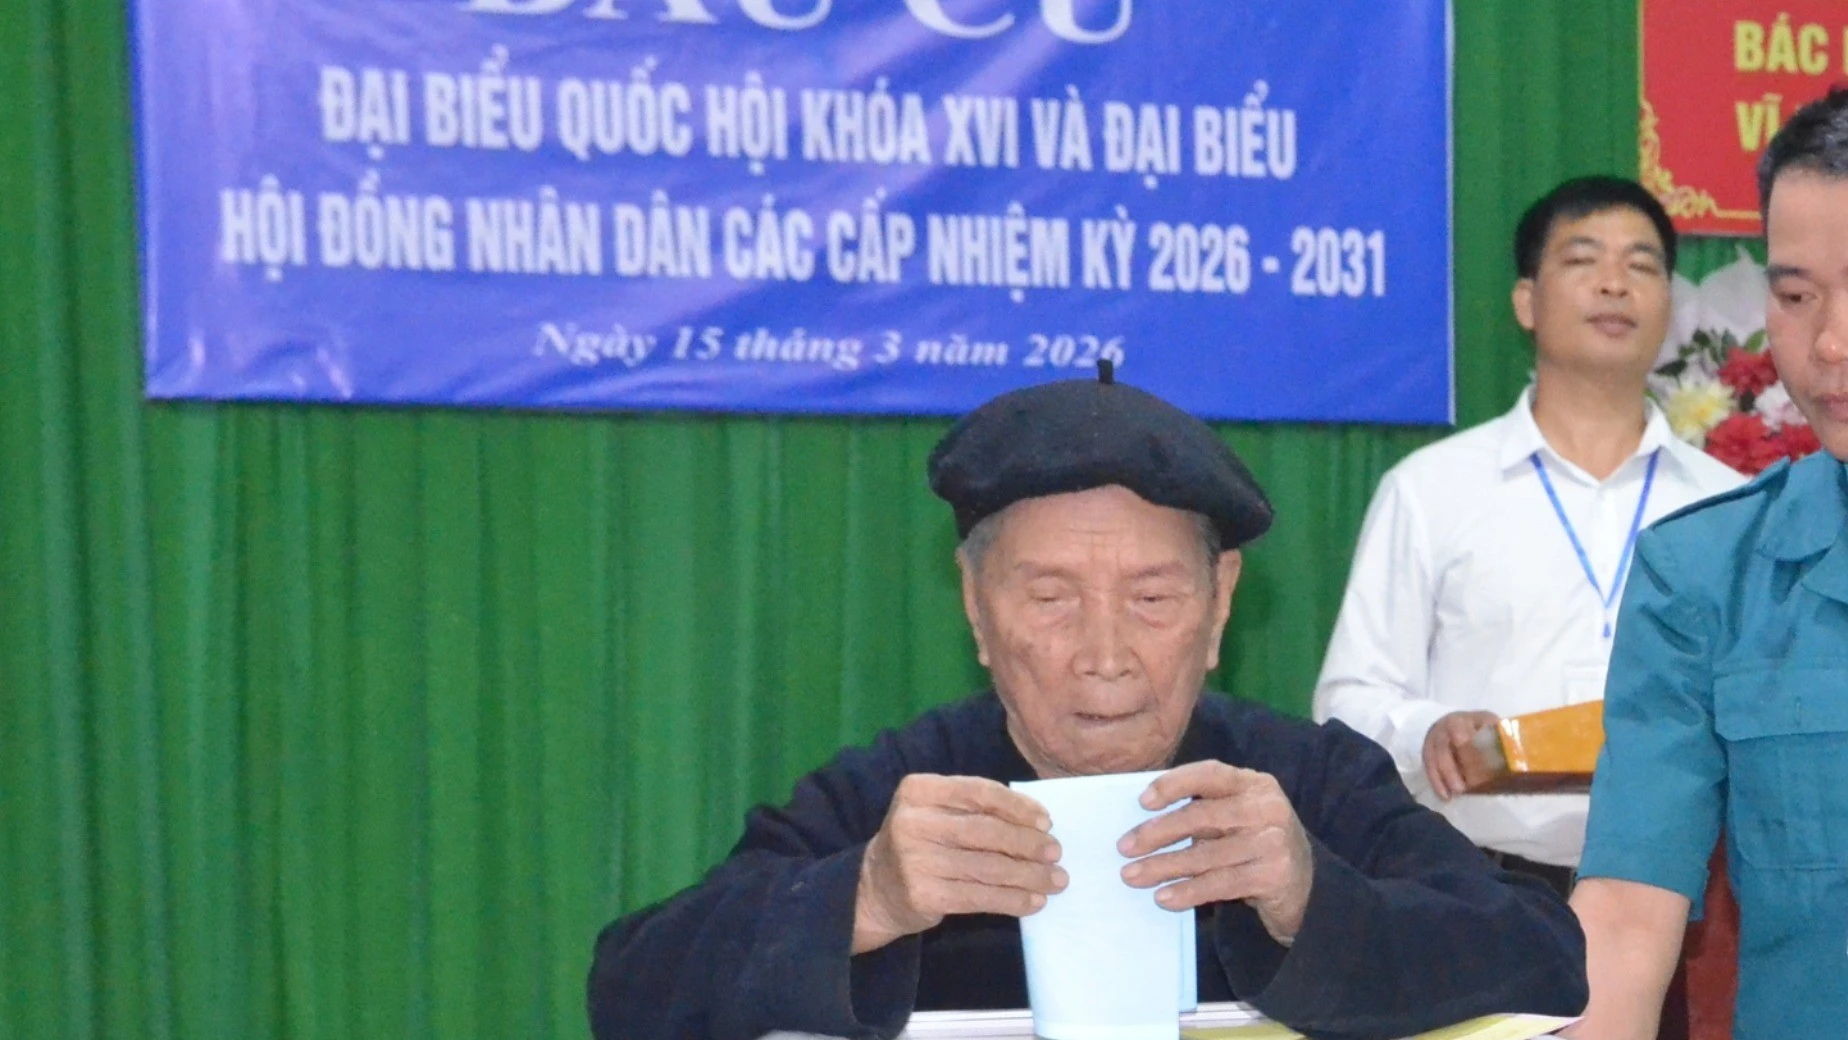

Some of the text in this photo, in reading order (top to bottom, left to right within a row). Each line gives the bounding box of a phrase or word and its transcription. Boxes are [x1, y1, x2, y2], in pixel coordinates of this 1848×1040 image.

[1733, 12, 1829, 75] BÁC
[318, 44, 1298, 190] ĐẠI BIỂU QUỐC HỘI KHÓA XVI VÀ ĐẠI BIỂU
[219, 168, 1386, 303] HỘI ĐỒNG NHÂN DÂN CÁC CẤP NHIỆM KỲ 2026 - 2031
[534, 321, 1126, 371] Ngày 15 tháng 3 năm 2026
